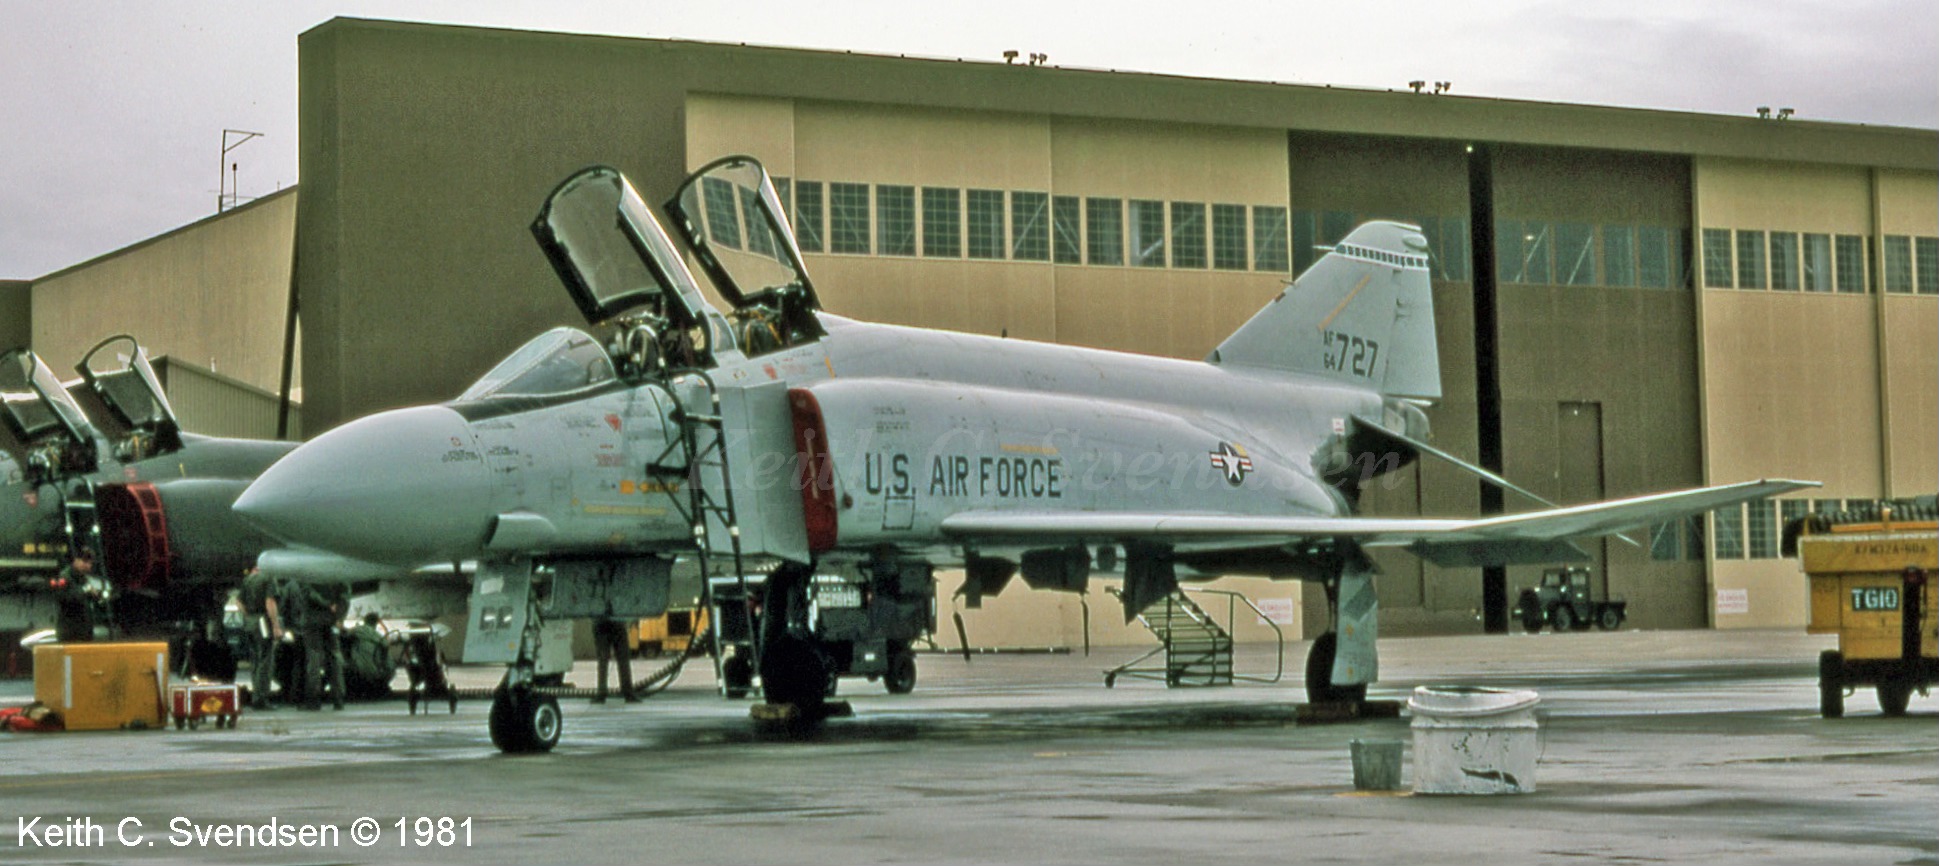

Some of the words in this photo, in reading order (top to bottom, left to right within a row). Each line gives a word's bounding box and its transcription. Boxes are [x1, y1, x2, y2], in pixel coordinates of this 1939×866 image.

[1336, 332, 1379, 378] 727
[865, 452, 916, 495] U.S.
[929, 454, 969, 497] AIR
[979, 456, 1062, 498] FORCE
